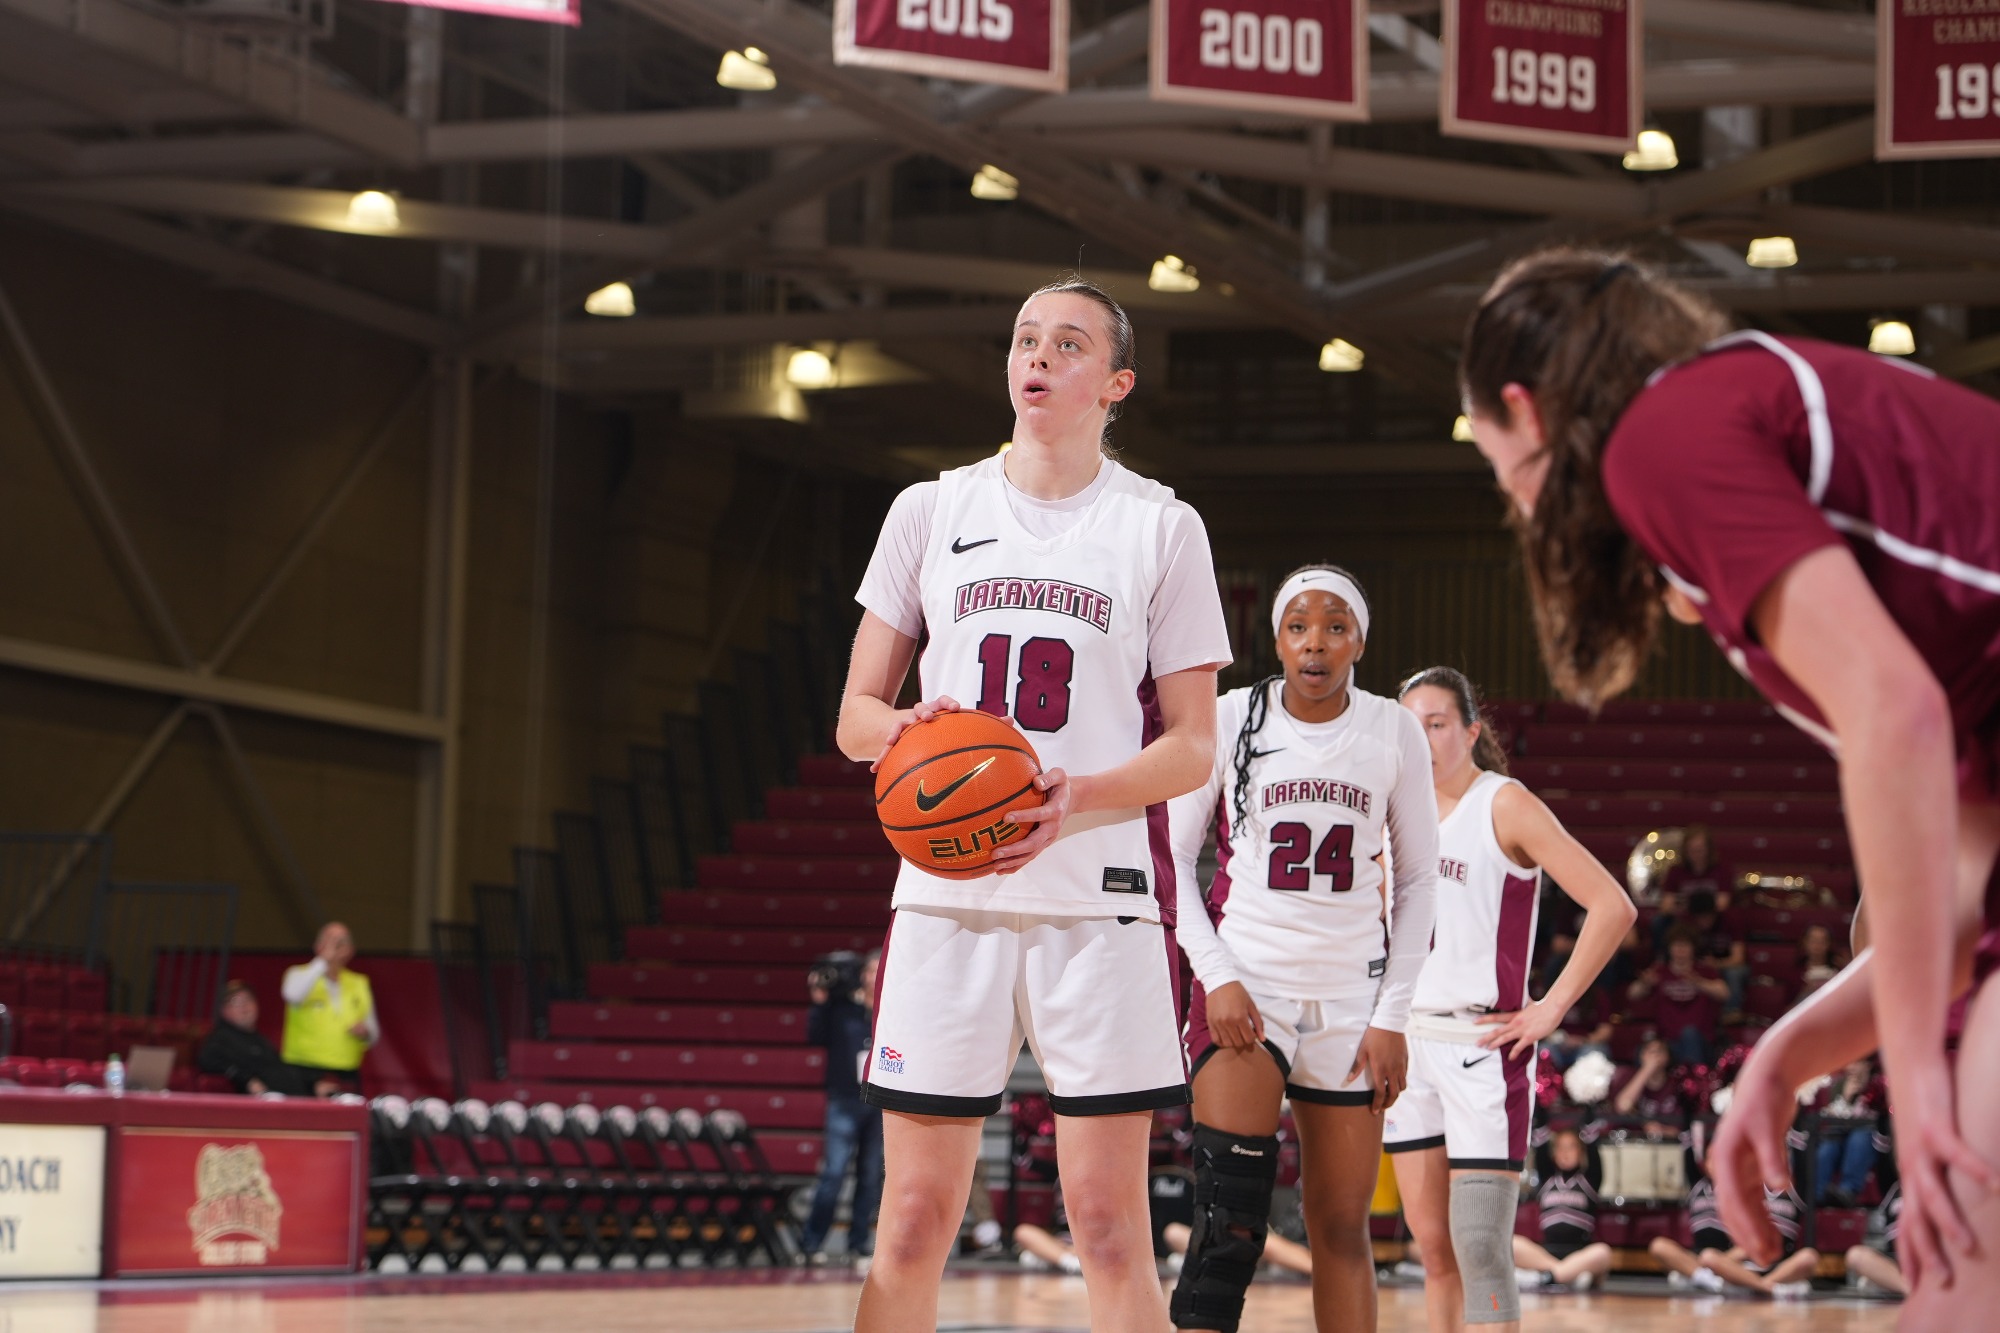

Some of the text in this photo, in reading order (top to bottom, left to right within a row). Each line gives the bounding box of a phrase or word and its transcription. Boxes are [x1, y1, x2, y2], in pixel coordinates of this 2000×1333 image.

[1200, 8, 1323, 77] 2000
[1484, 2, 1603, 38] CHAMPIONS
[1492, 47, 1597, 112] 1999
[956, 578, 1110, 631] LAFAYETTE
[976, 633, 1074, 733] 18
[1264, 780, 1371, 816] LAFAYETTE
[927, 820, 1020, 858] ELITE
[1268, 822, 1354, 892] 24
